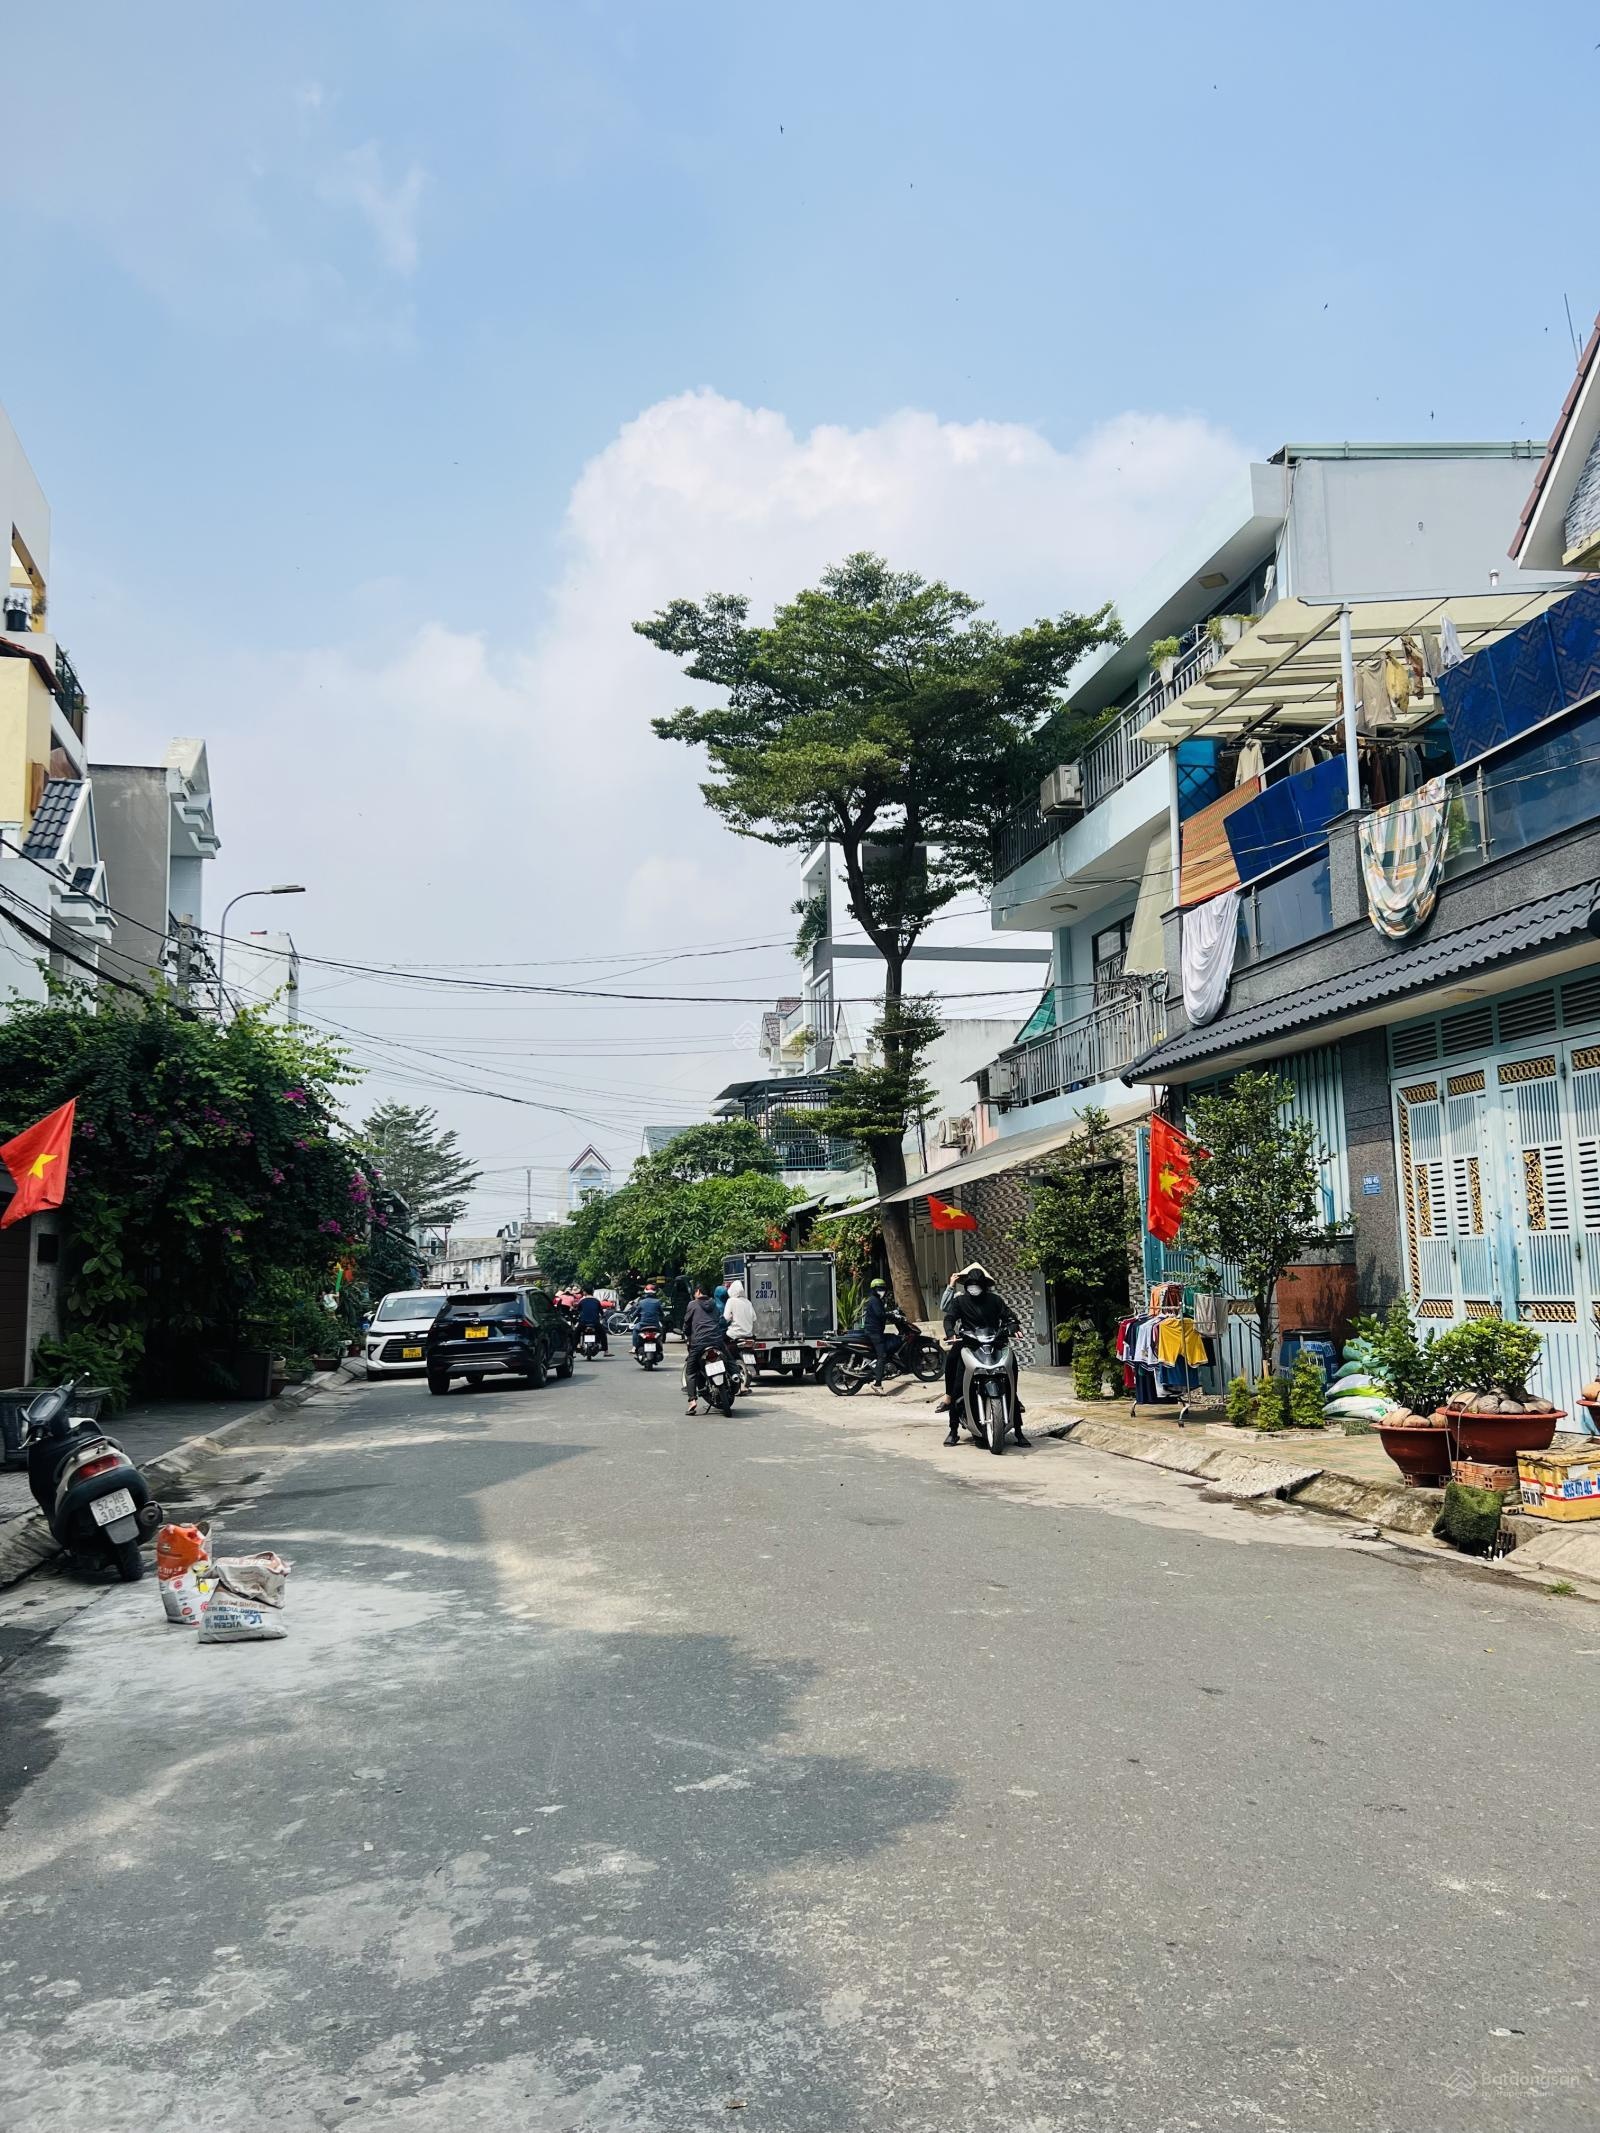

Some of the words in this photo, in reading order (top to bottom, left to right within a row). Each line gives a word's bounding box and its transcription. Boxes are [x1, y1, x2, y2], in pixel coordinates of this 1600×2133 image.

[761, 1281, 772, 1290] 51D
[755, 1289, 777, 1299] 238.71
[101, 1505, 130, 1522] 3095
